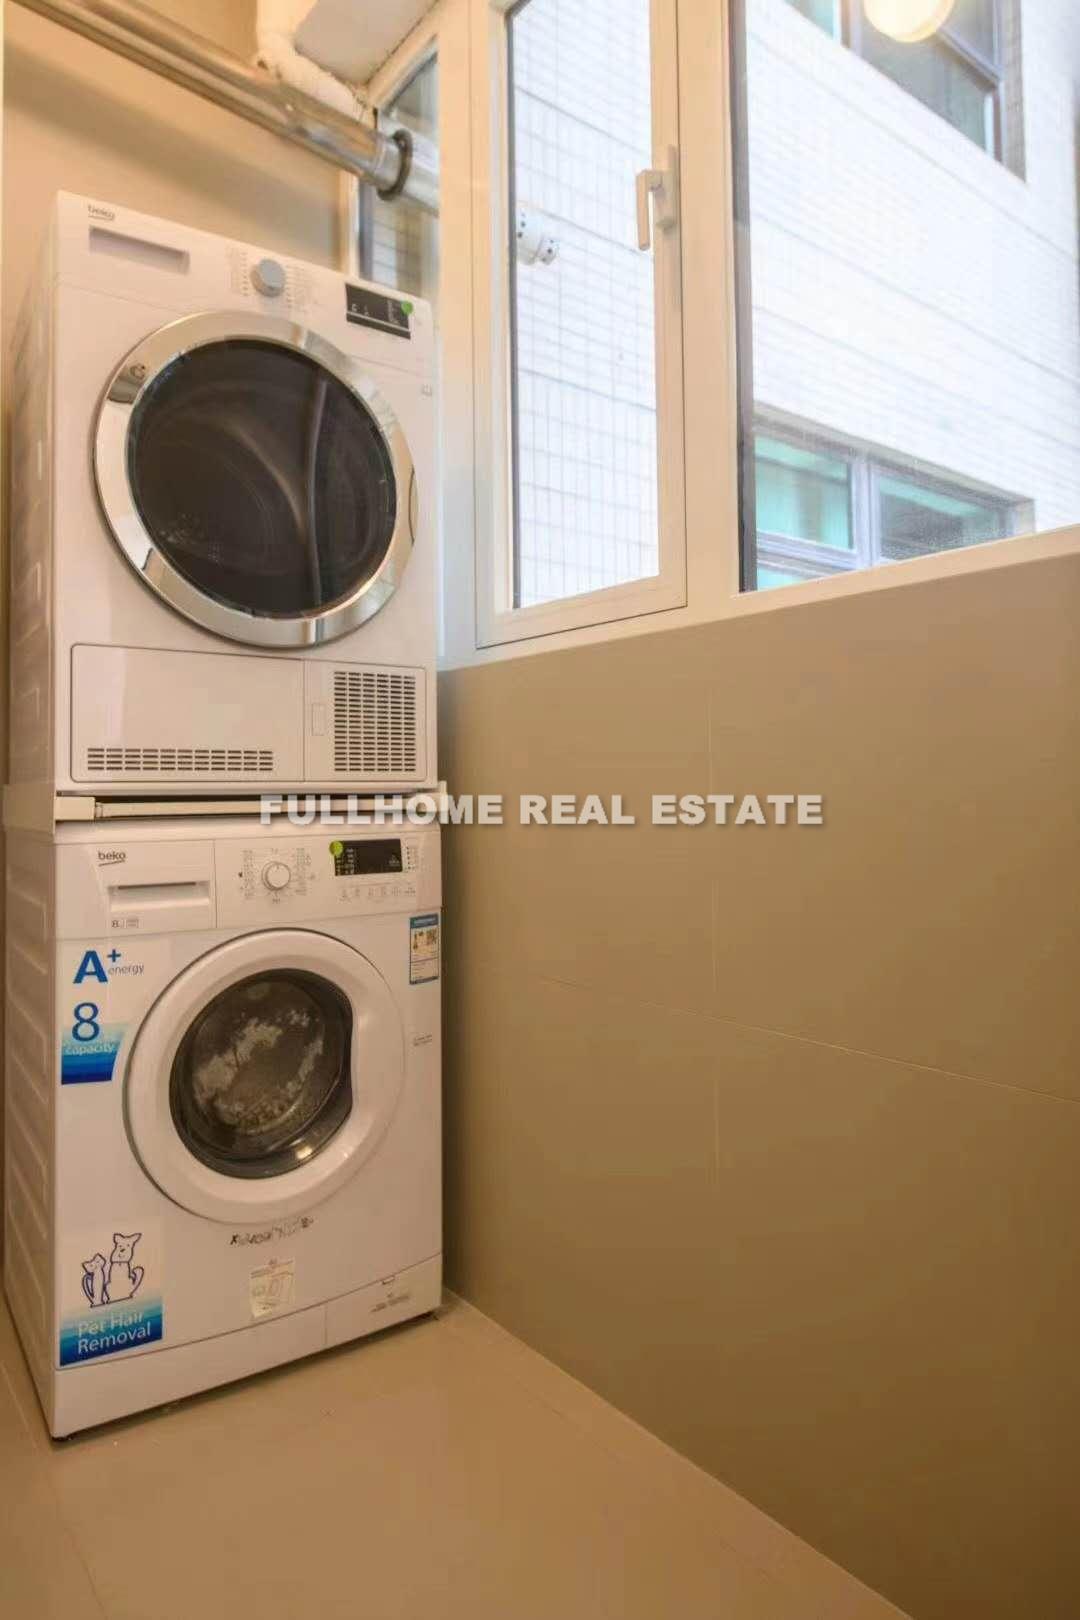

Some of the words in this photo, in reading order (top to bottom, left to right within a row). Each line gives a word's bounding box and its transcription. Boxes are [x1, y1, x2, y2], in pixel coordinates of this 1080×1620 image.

[97, 851, 127, 866] beko
[108, 962, 145, 977] energy
[71, 1001, 100, 1042] 8
[77, 1318, 105, 1337] Pet
[109, 1311, 145, 1331] Hair
[77, 1321, 152, 1355] Removal
